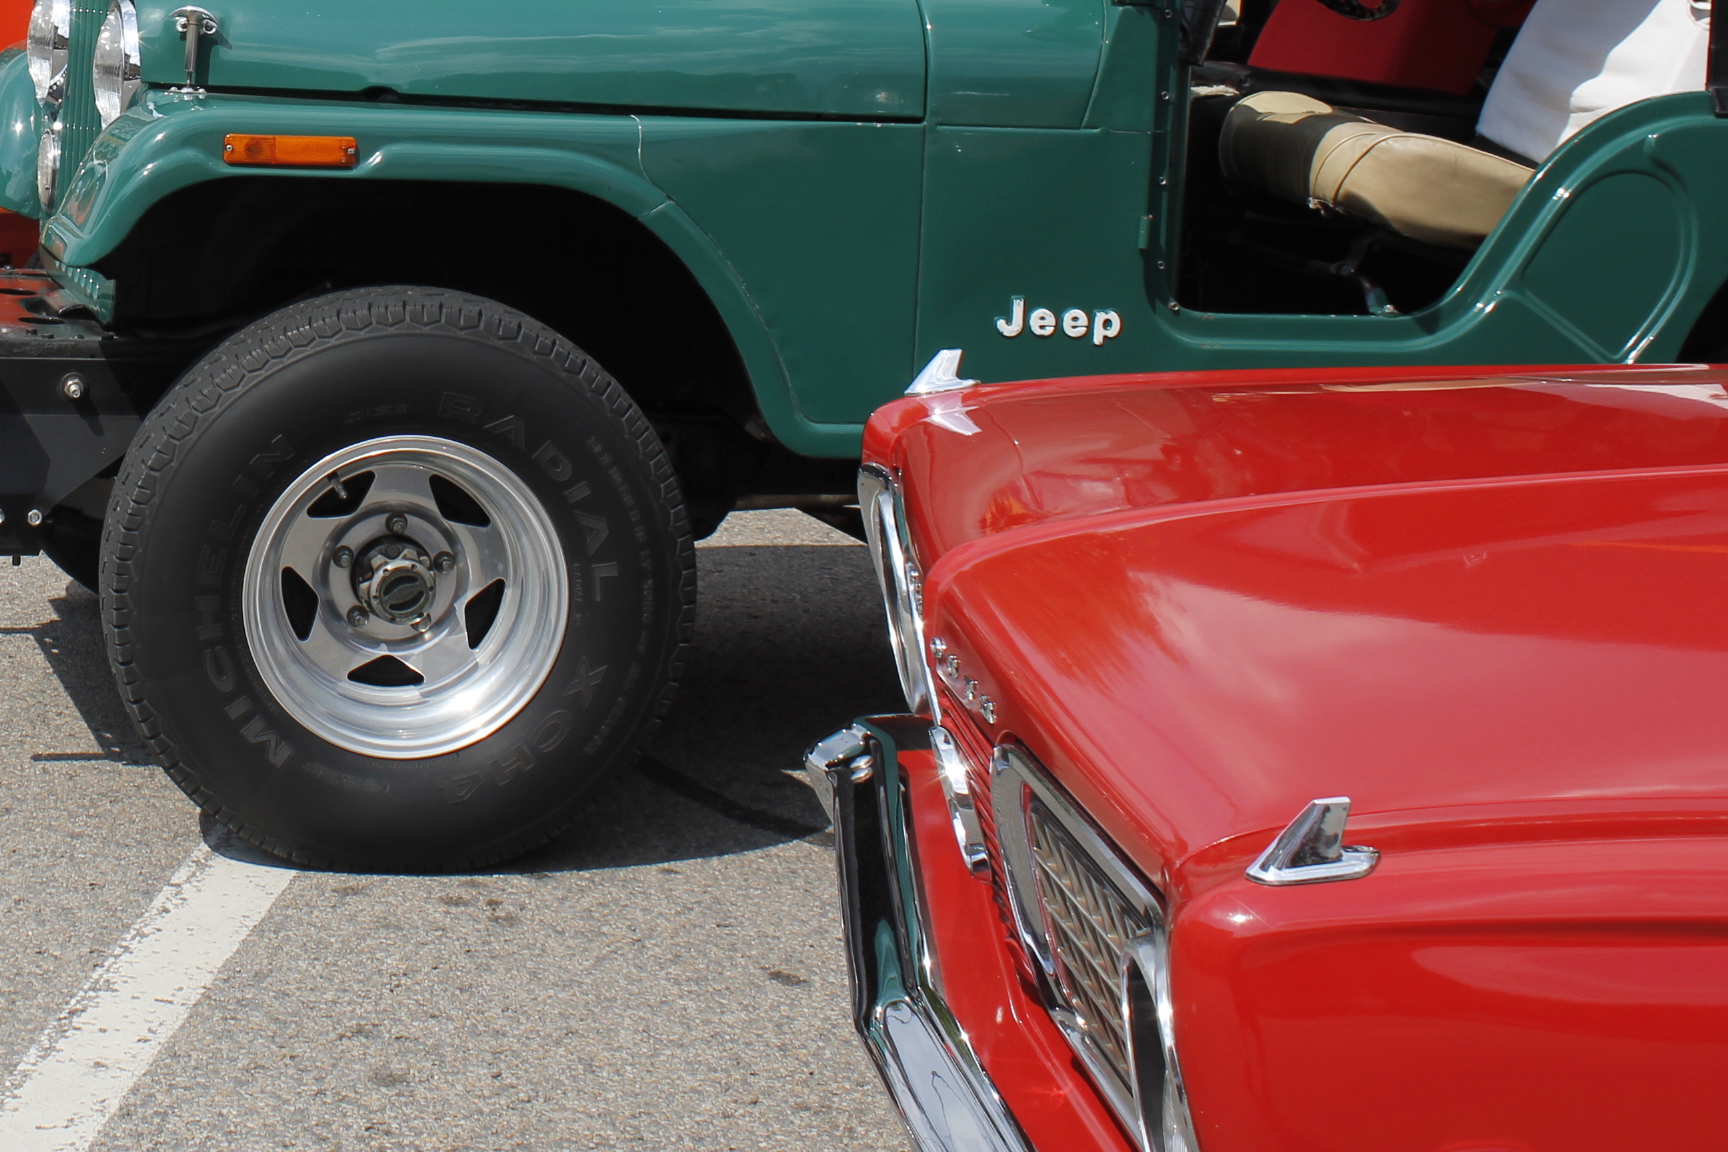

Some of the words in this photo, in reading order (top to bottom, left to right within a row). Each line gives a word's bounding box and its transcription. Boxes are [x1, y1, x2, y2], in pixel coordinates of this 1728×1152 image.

[996, 297, 1121, 346] Jeep
[194, 434, 296, 770] MICHELIN
[438, 392, 619, 603] RADIAL
